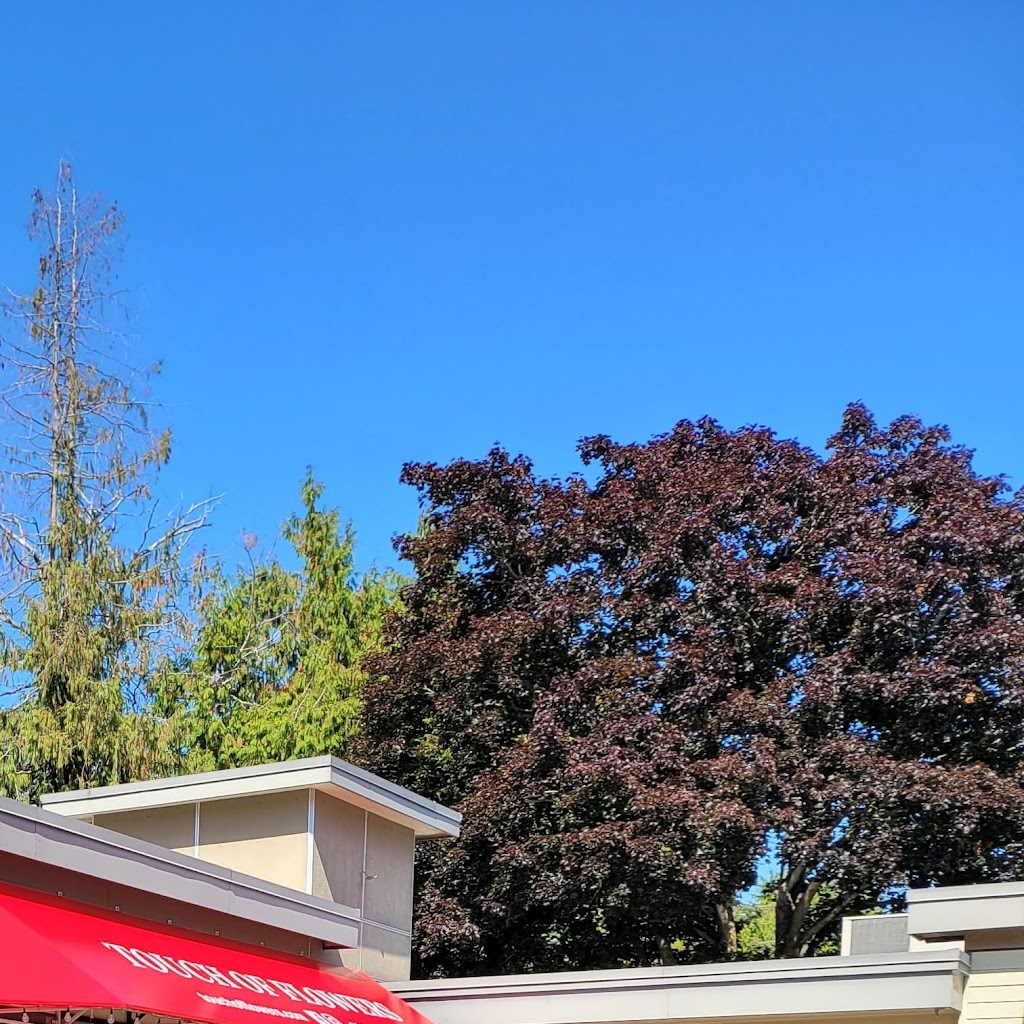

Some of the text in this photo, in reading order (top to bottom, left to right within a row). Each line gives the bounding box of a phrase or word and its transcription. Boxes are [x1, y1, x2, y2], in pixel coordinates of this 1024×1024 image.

[101, 941, 404, 1022] TOUCH OF FLOWERS
